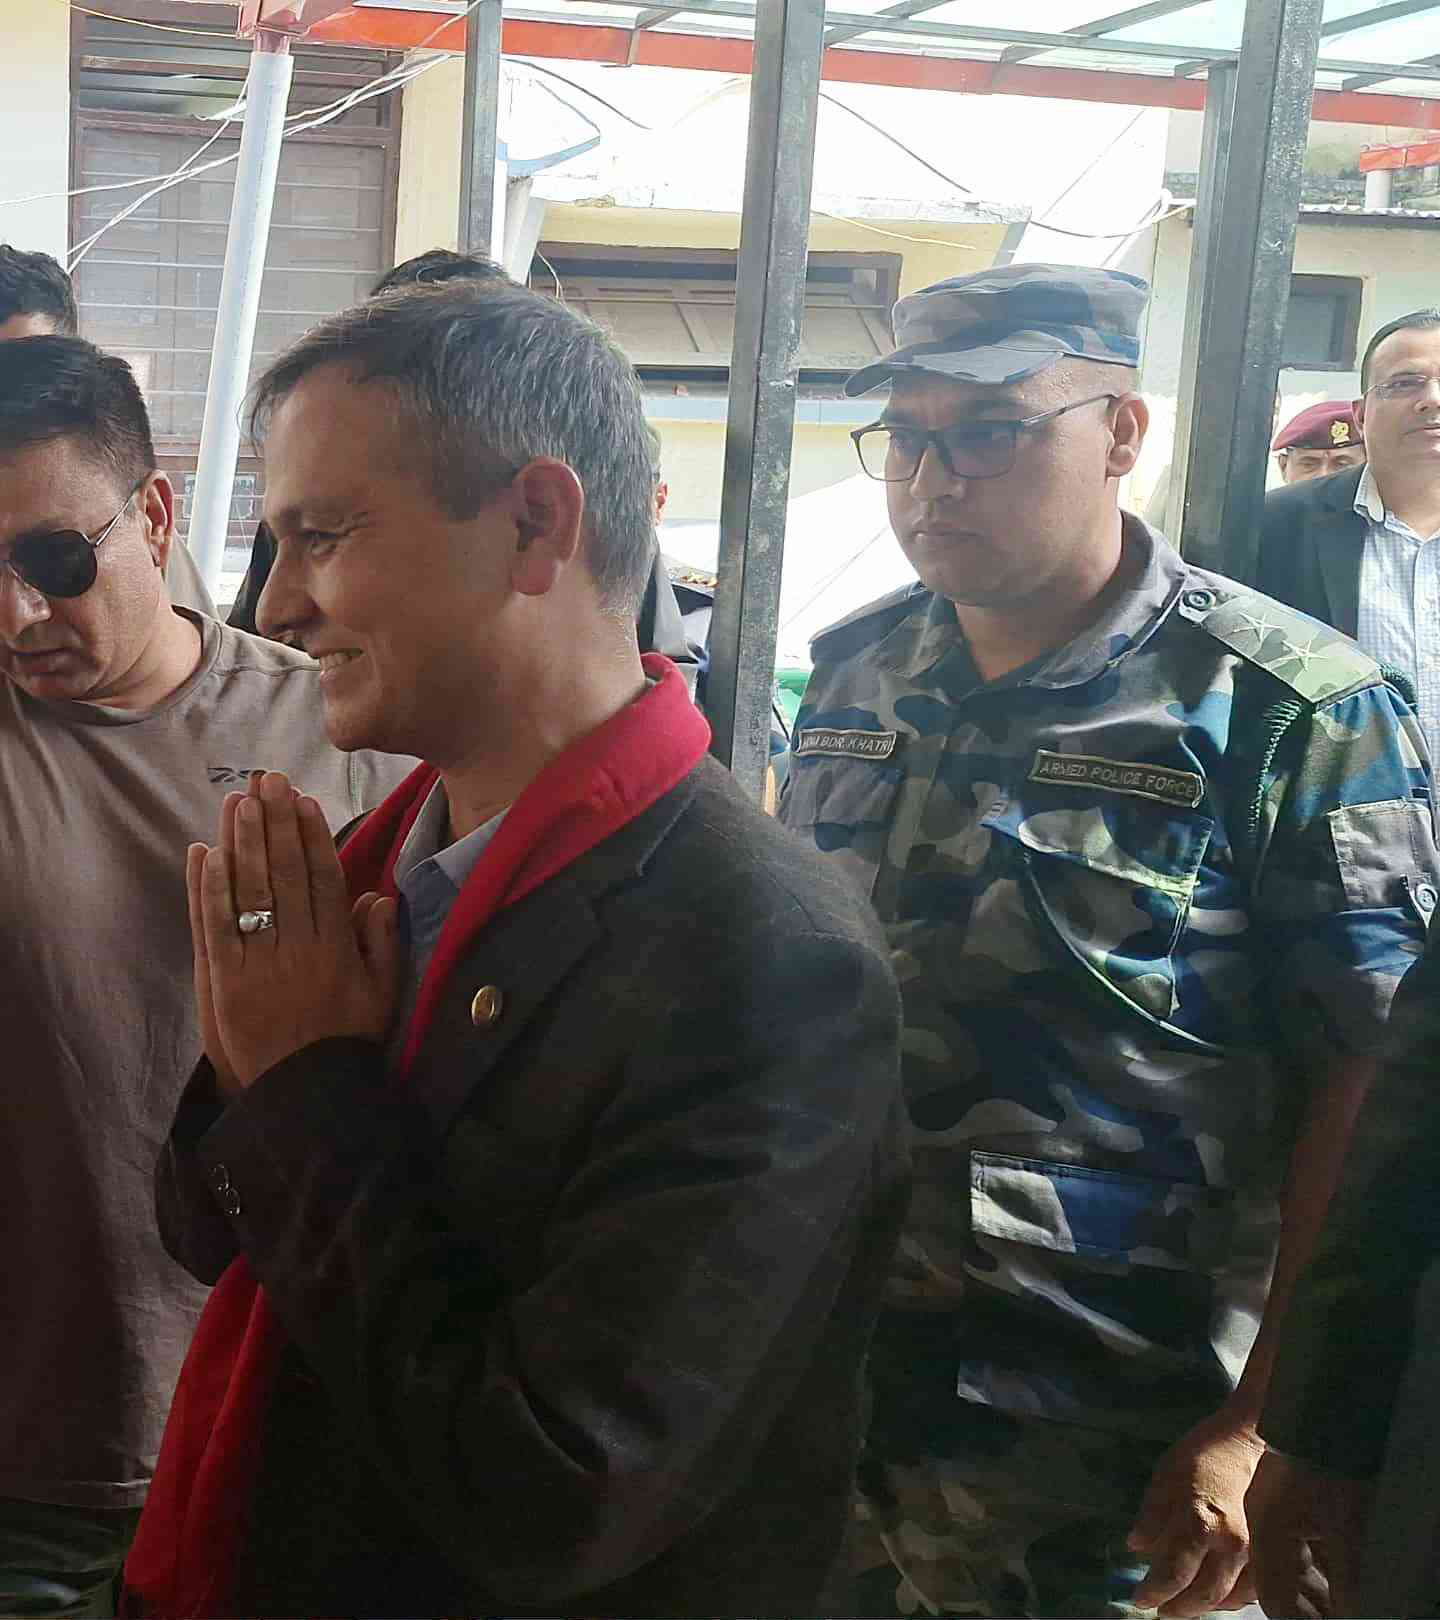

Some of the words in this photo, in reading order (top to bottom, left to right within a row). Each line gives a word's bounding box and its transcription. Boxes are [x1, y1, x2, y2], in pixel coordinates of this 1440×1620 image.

[1039, 759, 1088, 777] ARMED
[1090, 766, 1142, 786] POLICE
[1145, 775, 1195, 798] FORCE
